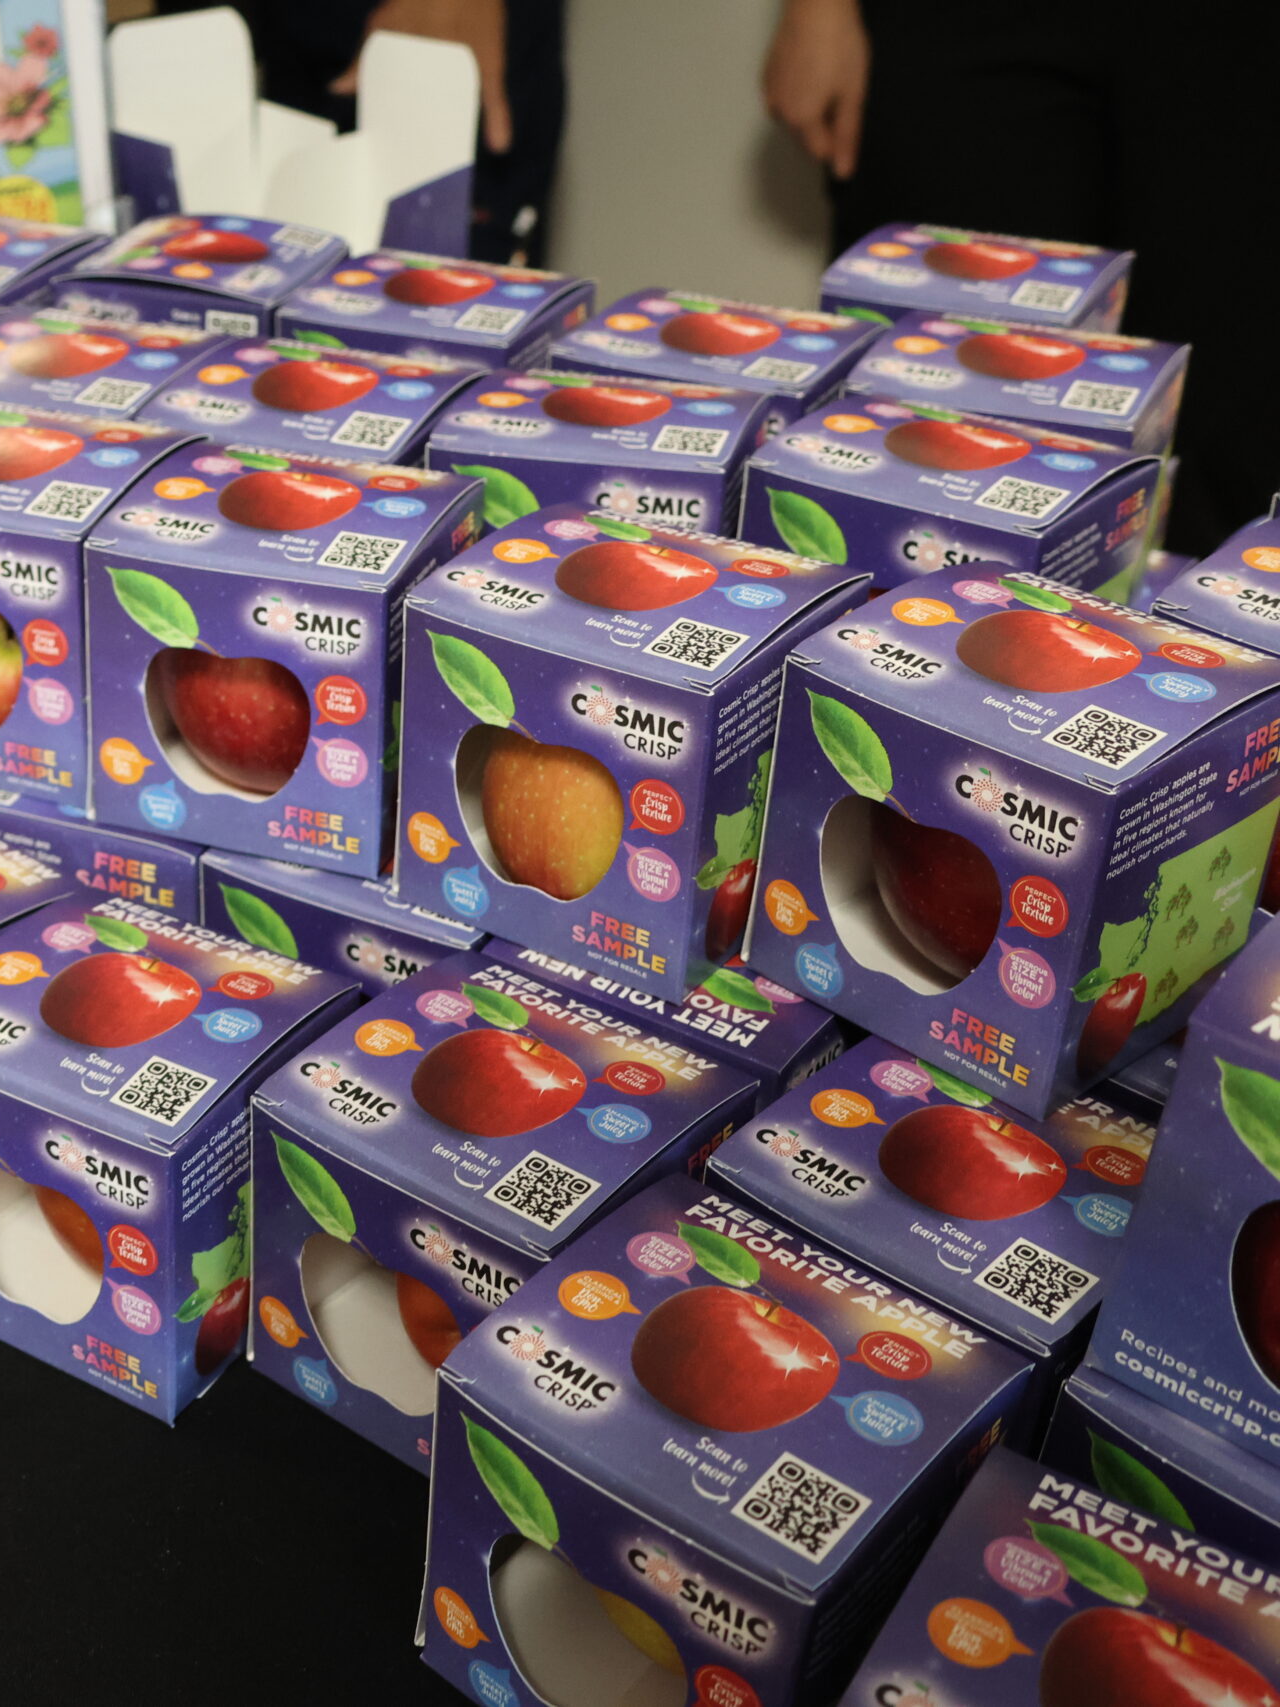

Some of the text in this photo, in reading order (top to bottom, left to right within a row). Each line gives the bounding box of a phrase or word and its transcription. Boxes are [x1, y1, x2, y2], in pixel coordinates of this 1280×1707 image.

[120, 510, 214, 533] COSMIC
[596, 491, 701, 519] COSMIC
[902, 538, 984, 571] COSM
[9, 582, 57, 601] CRISP
[446, 570, 545, 604] COSMIC
[479, 592, 531, 612] CRISP
[1196, 576, 1280, 607] COSM
[252, 606, 362, 639] COSMIC
[585, 617, 615, 634] learn
[611, 614, 639, 627] Scan
[304, 636, 359, 656] CRISP
[836, 628, 942, 676] COSMIC
[870, 656, 927, 681] CRISP
[571, 692, 685, 744] COSMIC
[719, 696, 742, 718] Cosmic
[982, 693, 1046, 726] learn more!
[1011, 693, 1058, 717] Scan to
[3, 741, 57, 767] FREE
[623, 733, 680, 761] CRISP
[1244, 718, 1280, 757] FRE
[1225, 746, 1280, 792] SAMP
[642, 789, 672, 802] PERFECT
[645, 797, 668, 814] Crisp
[954, 774, 1079, 842] COSMIC
[1116, 816, 1142, 838] grown
[1143, 811, 1150, 820] in
[1152, 784, 1197, 815] Washington
[1198, 772, 1218, 789] State
[1120, 762, 1211, 820] Cosmic Crisp apples are
[284, 805, 344, 832] FREE
[640, 804, 672, 823] Texture
[1113, 792, 1208, 850] in five regions known for
[266, 820, 360, 854] SAMPLE
[1008, 823, 1072, 859] CRISP
[1110, 801, 1215, 866] ideal climates that naturally
[94, 851, 157, 883] FREE
[1106, 830, 1188, 881] nourish our orchards.
[1025, 886, 1057, 904] PERFECT
[1026, 894, 1051, 913] Crisp
[589, 910, 650, 949] FREE
[1020, 901, 1054, 925] Texture
[92, 903, 309, 985] FAVORITE APPLE
[183, 922, 253, 953] YOUR
[254, 950, 323, 976] NEW
[571, 924, 667, 975] SAMPLE
[587, 950, 602, 959] NOT
[1009, 970, 1042, 995] Vibrant
[1010, 954, 1048, 977] GENEROUS
[1011, 962, 1037, 980] SIZE
[1012, 983, 1035, 1001] Color
[469, 971, 702, 1082] FAVORITE APPLE
[486, 965, 718, 1071] MEET YOUR NEW
[672, 1007, 758, 1048] MEET
[688, 993, 771, 1033] FAVO
[950, 1008, 1017, 1056] FREE
[928, 1020, 1030, 1089] SAMPLE
[943, 1049, 1008, 1090] NOT FOR RESALE
[299, 1061, 398, 1118] COSMIC
[328, 1096, 379, 1127] CRISP
[45, 1139, 150, 1196] COSMIC
[182, 1143, 208, 1171] Cosmic
[432, 1142, 490, 1180] learn more!
[459, 1139, 502, 1168] Scan to
[756, 1128, 867, 1193] COSMIC
[95, 1181, 147, 1210] CRISP
[791, 1166, 851, 1200] CRISP
[909, 1220, 978, 1263] learn more!
[939, 1220, 988, 1253] Scan to
[409, 1228, 524, 1297] COSMIC
[701, 1195, 988, 1345] MEET YOUR NEW
[461, 1276, 508, 1308] CRIS
[684, 1205, 973, 1361] FAVORITE APPLE
[85, 1333, 142, 1374] FREE
[496, 1324, 617, 1405] COSMIC
[870, 1345, 910, 1372] Texture
[881, 1343, 911, 1362] Crisp
[71, 1343, 158, 1400] SAMPLE
[1121, 1328, 1280, 1423] Recipes and mo
[532, 1372, 597, 1414] CRISP
[1114, 1351, 1280, 1447] cosmiccrisp.c
[860, 1414, 893, 1438] Juicy
[863, 1404, 897, 1427] Sweet
[662, 1437, 738, 1489] learn more!
[694, 1435, 749, 1472] Scan to
[1038, 1473, 1158, 1536] MEET
[1028, 1491, 1250, 1606] FAVORITE
[626, 1548, 770, 1645] COSMIC
[689, 1610, 762, 1656] CRISP
